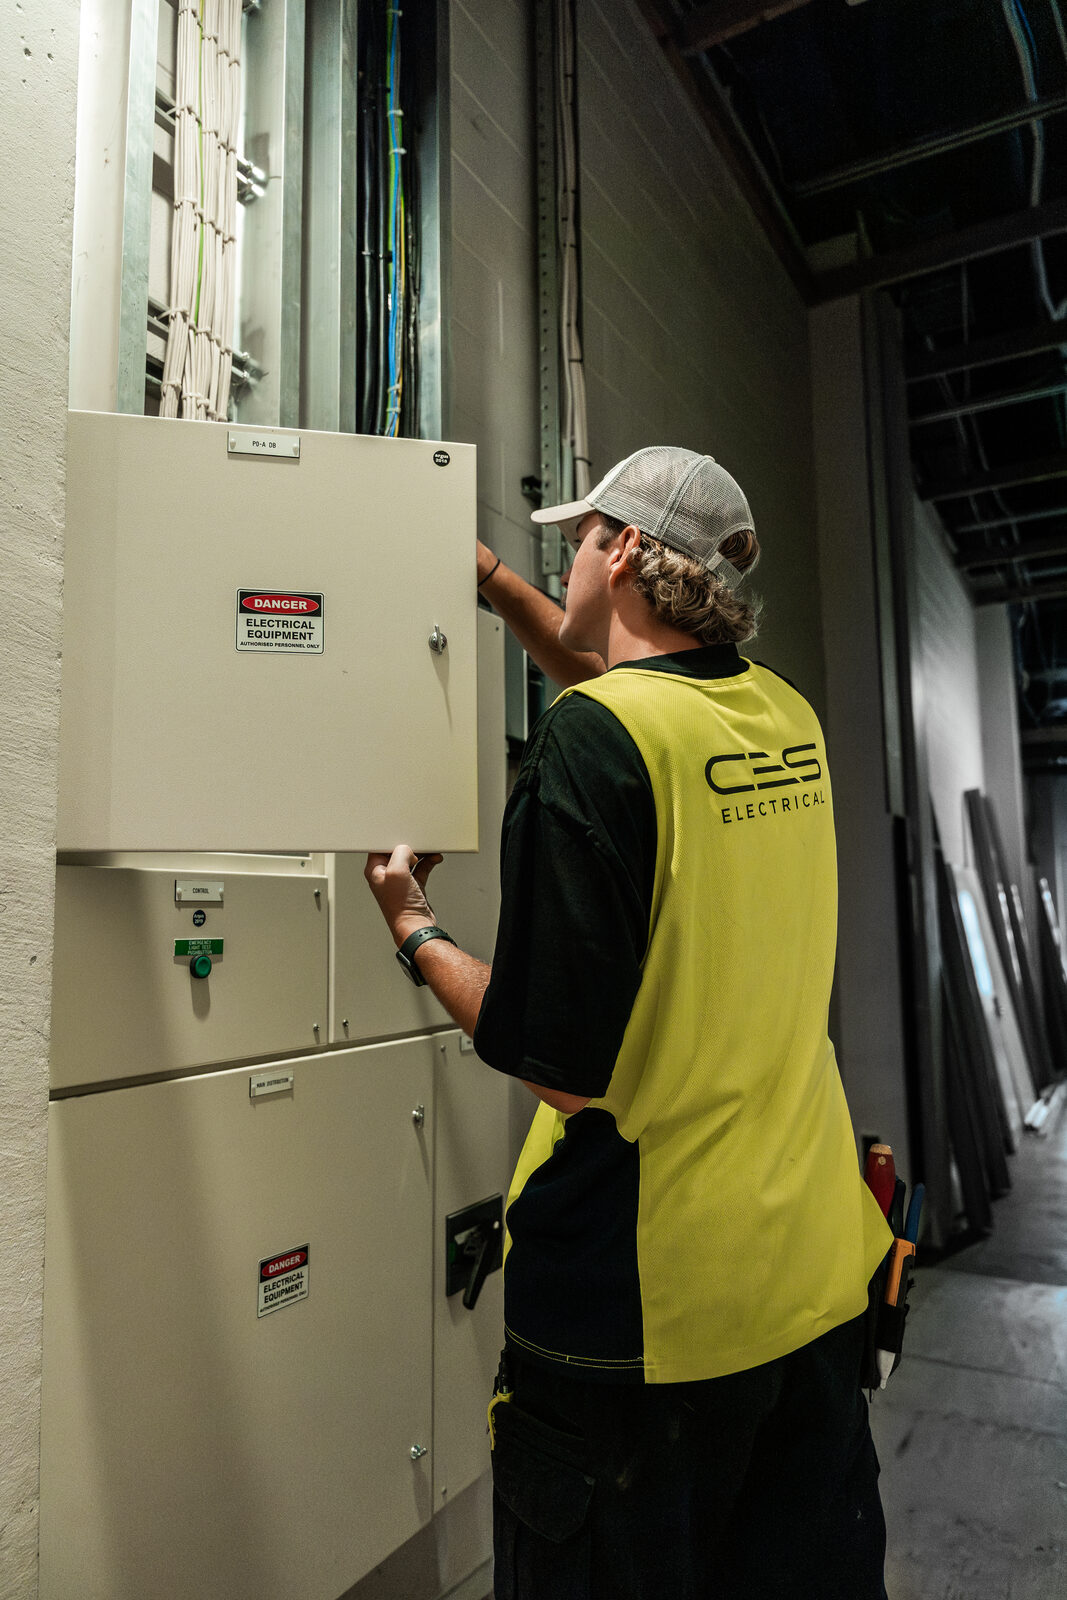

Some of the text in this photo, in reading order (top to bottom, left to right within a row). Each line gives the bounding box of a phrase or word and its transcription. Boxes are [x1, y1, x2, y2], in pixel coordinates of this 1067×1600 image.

[254, 598, 308, 610] DANGER
[246, 618, 315, 630] ELECTRICAL
[247, 630, 314, 641] EQUIPMENT
[704, 743, 821, 795] CES
[721, 790, 825, 824] ELECTRICAL
[269, 1255, 301, 1273] DANGER
[263, 1271, 304, 1294] ELECTRICAL
[264, 1281, 303, 1303] EQUIPMENT
